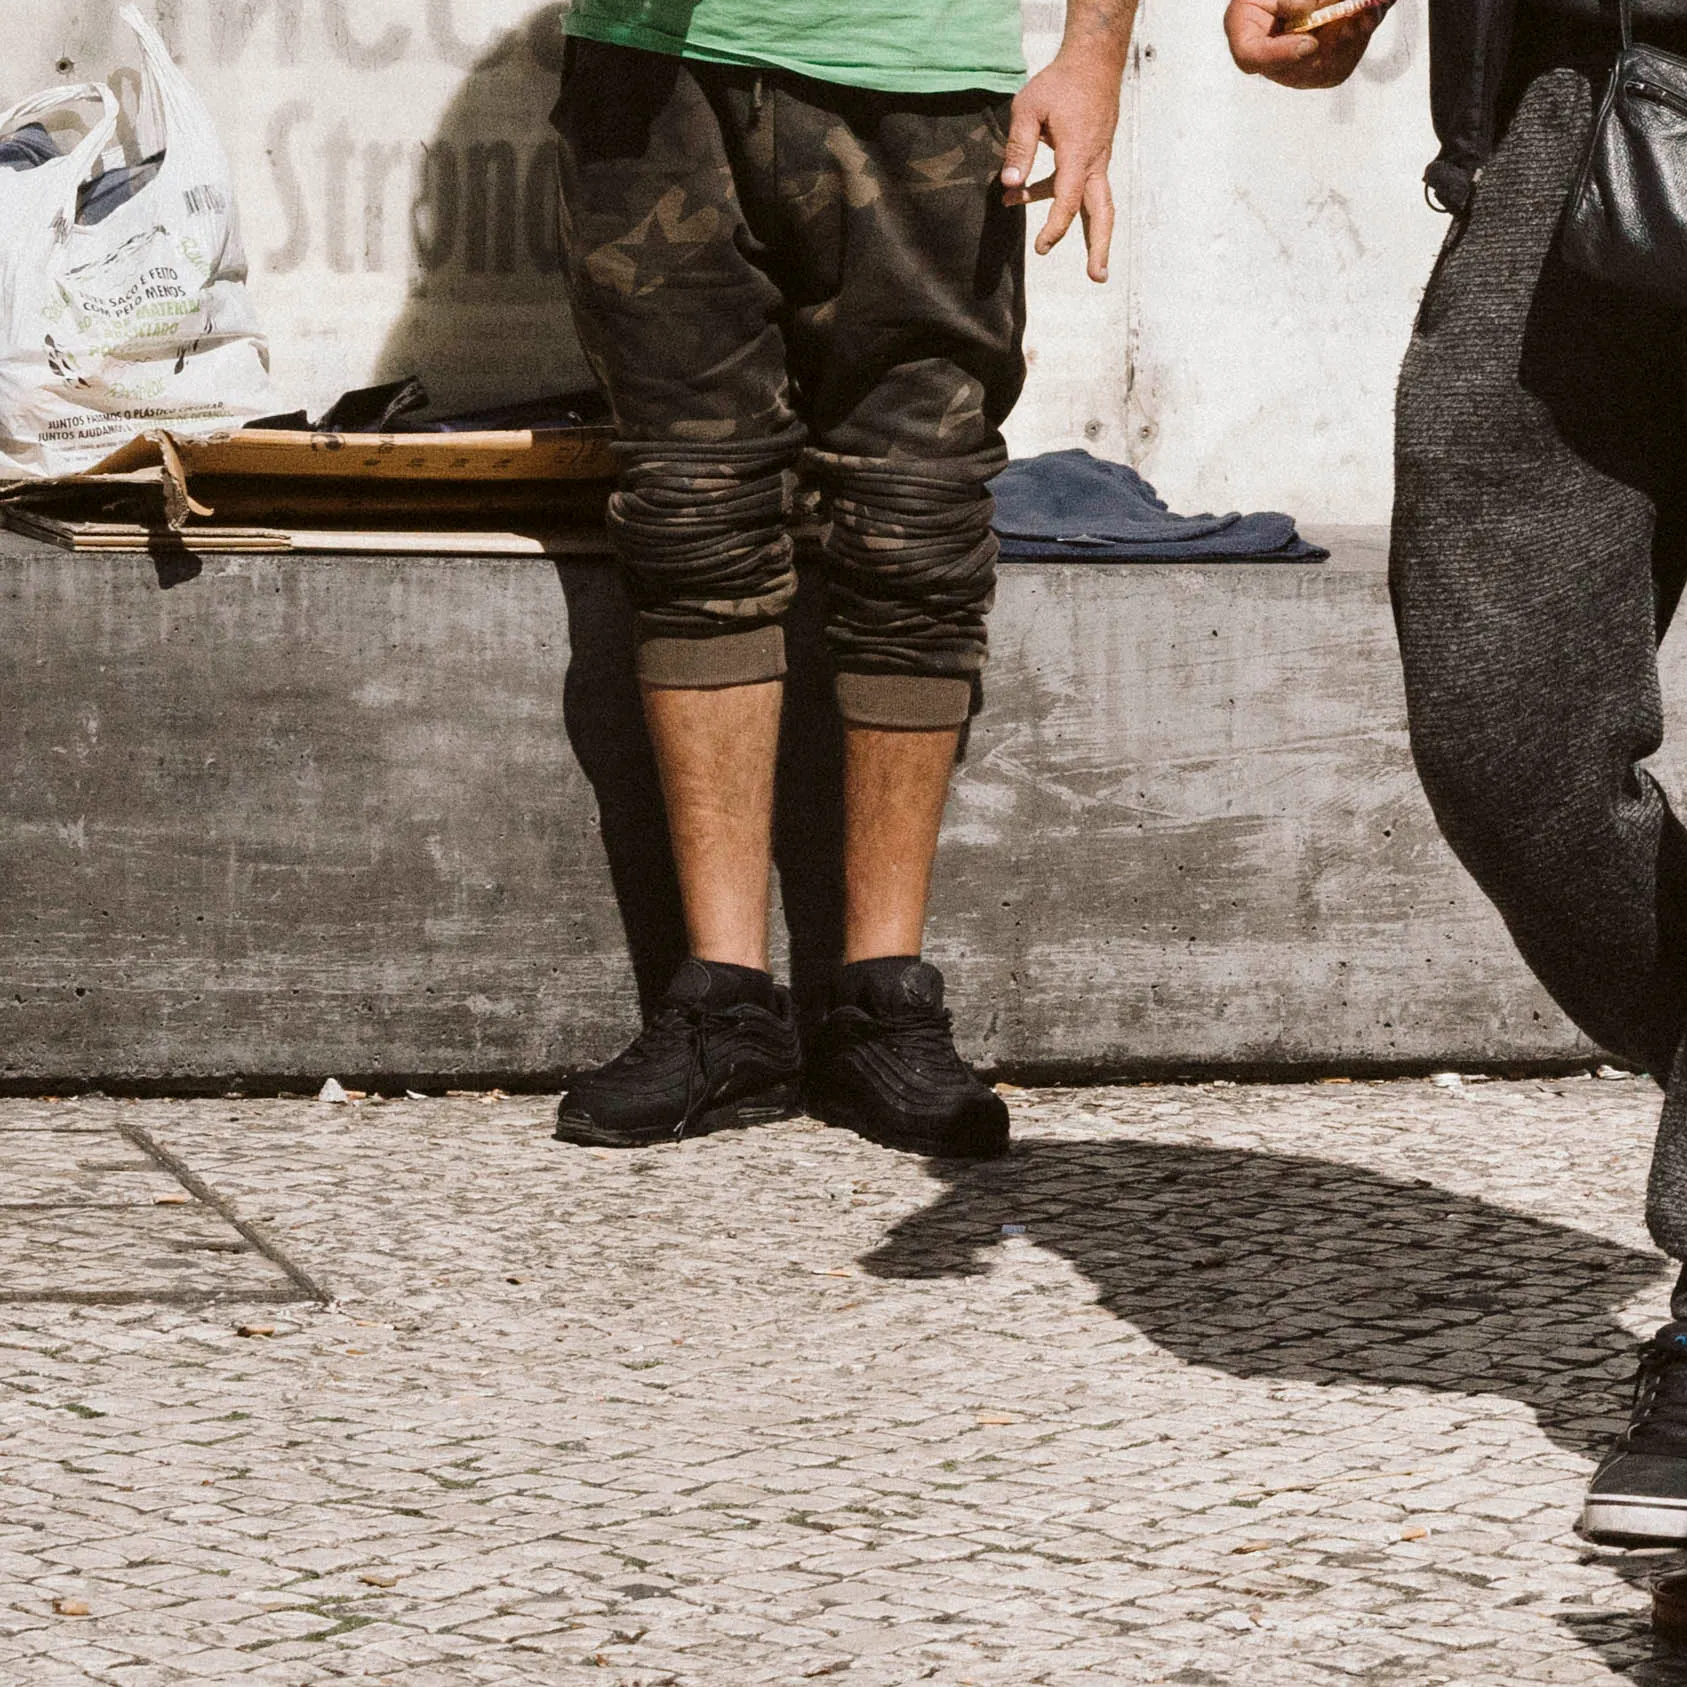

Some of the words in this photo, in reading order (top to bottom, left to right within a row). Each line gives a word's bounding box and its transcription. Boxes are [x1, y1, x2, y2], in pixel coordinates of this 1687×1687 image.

[149, 266, 179, 281] FEITO
[145, 284, 187, 300] MENOS
[48, 415, 85, 430] JUNTOS
[38, 430, 75, 442] JUNTOS
